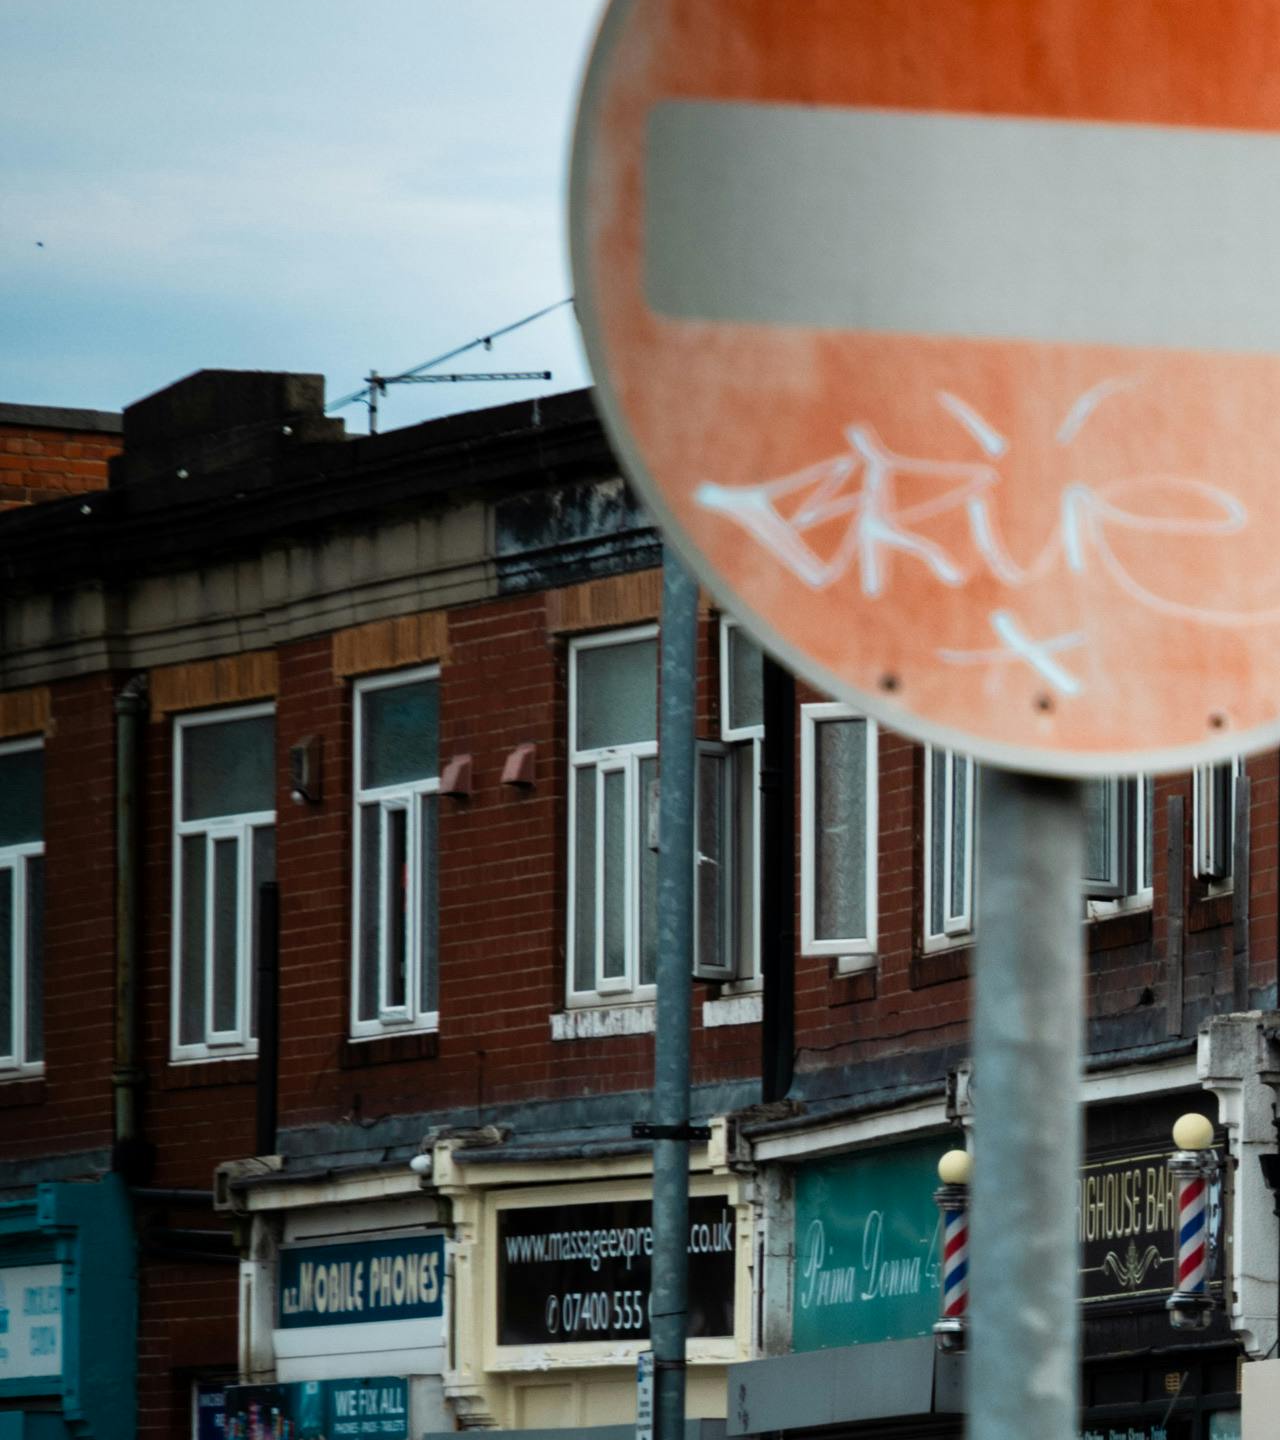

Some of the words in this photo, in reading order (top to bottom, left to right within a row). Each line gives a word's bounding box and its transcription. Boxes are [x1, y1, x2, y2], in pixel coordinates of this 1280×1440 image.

[1076, 1169, 1142, 1243] IGHOUSE
[300, 1261, 364, 1314] MOBILE
[369, 1251, 440, 1308] PHONES
[562, 1291, 609, 1333] 07400
[613, 1289, 643, 1331] 555
[333, 1390, 357, 1417] WE
[358, 1389, 379, 1415] FIX
[380, 1387, 405, 1414] ALL
